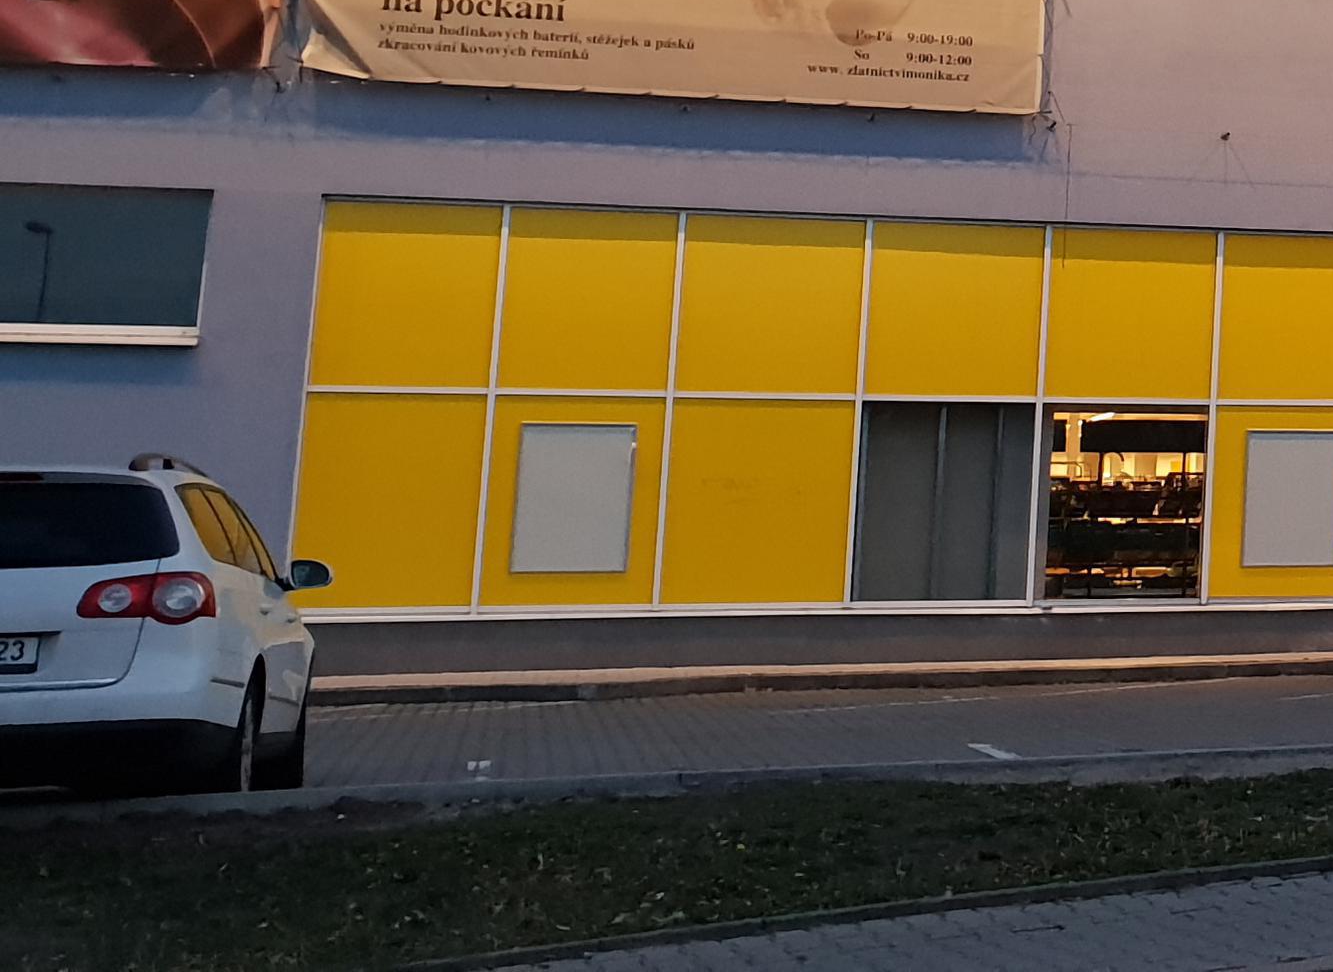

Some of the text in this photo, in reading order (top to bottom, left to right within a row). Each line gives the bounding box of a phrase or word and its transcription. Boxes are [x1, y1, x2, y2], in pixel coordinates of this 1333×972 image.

[907, 32, 973, 47] 9:00-19:00
[854, 48, 972, 66] So 9:00-12:00
